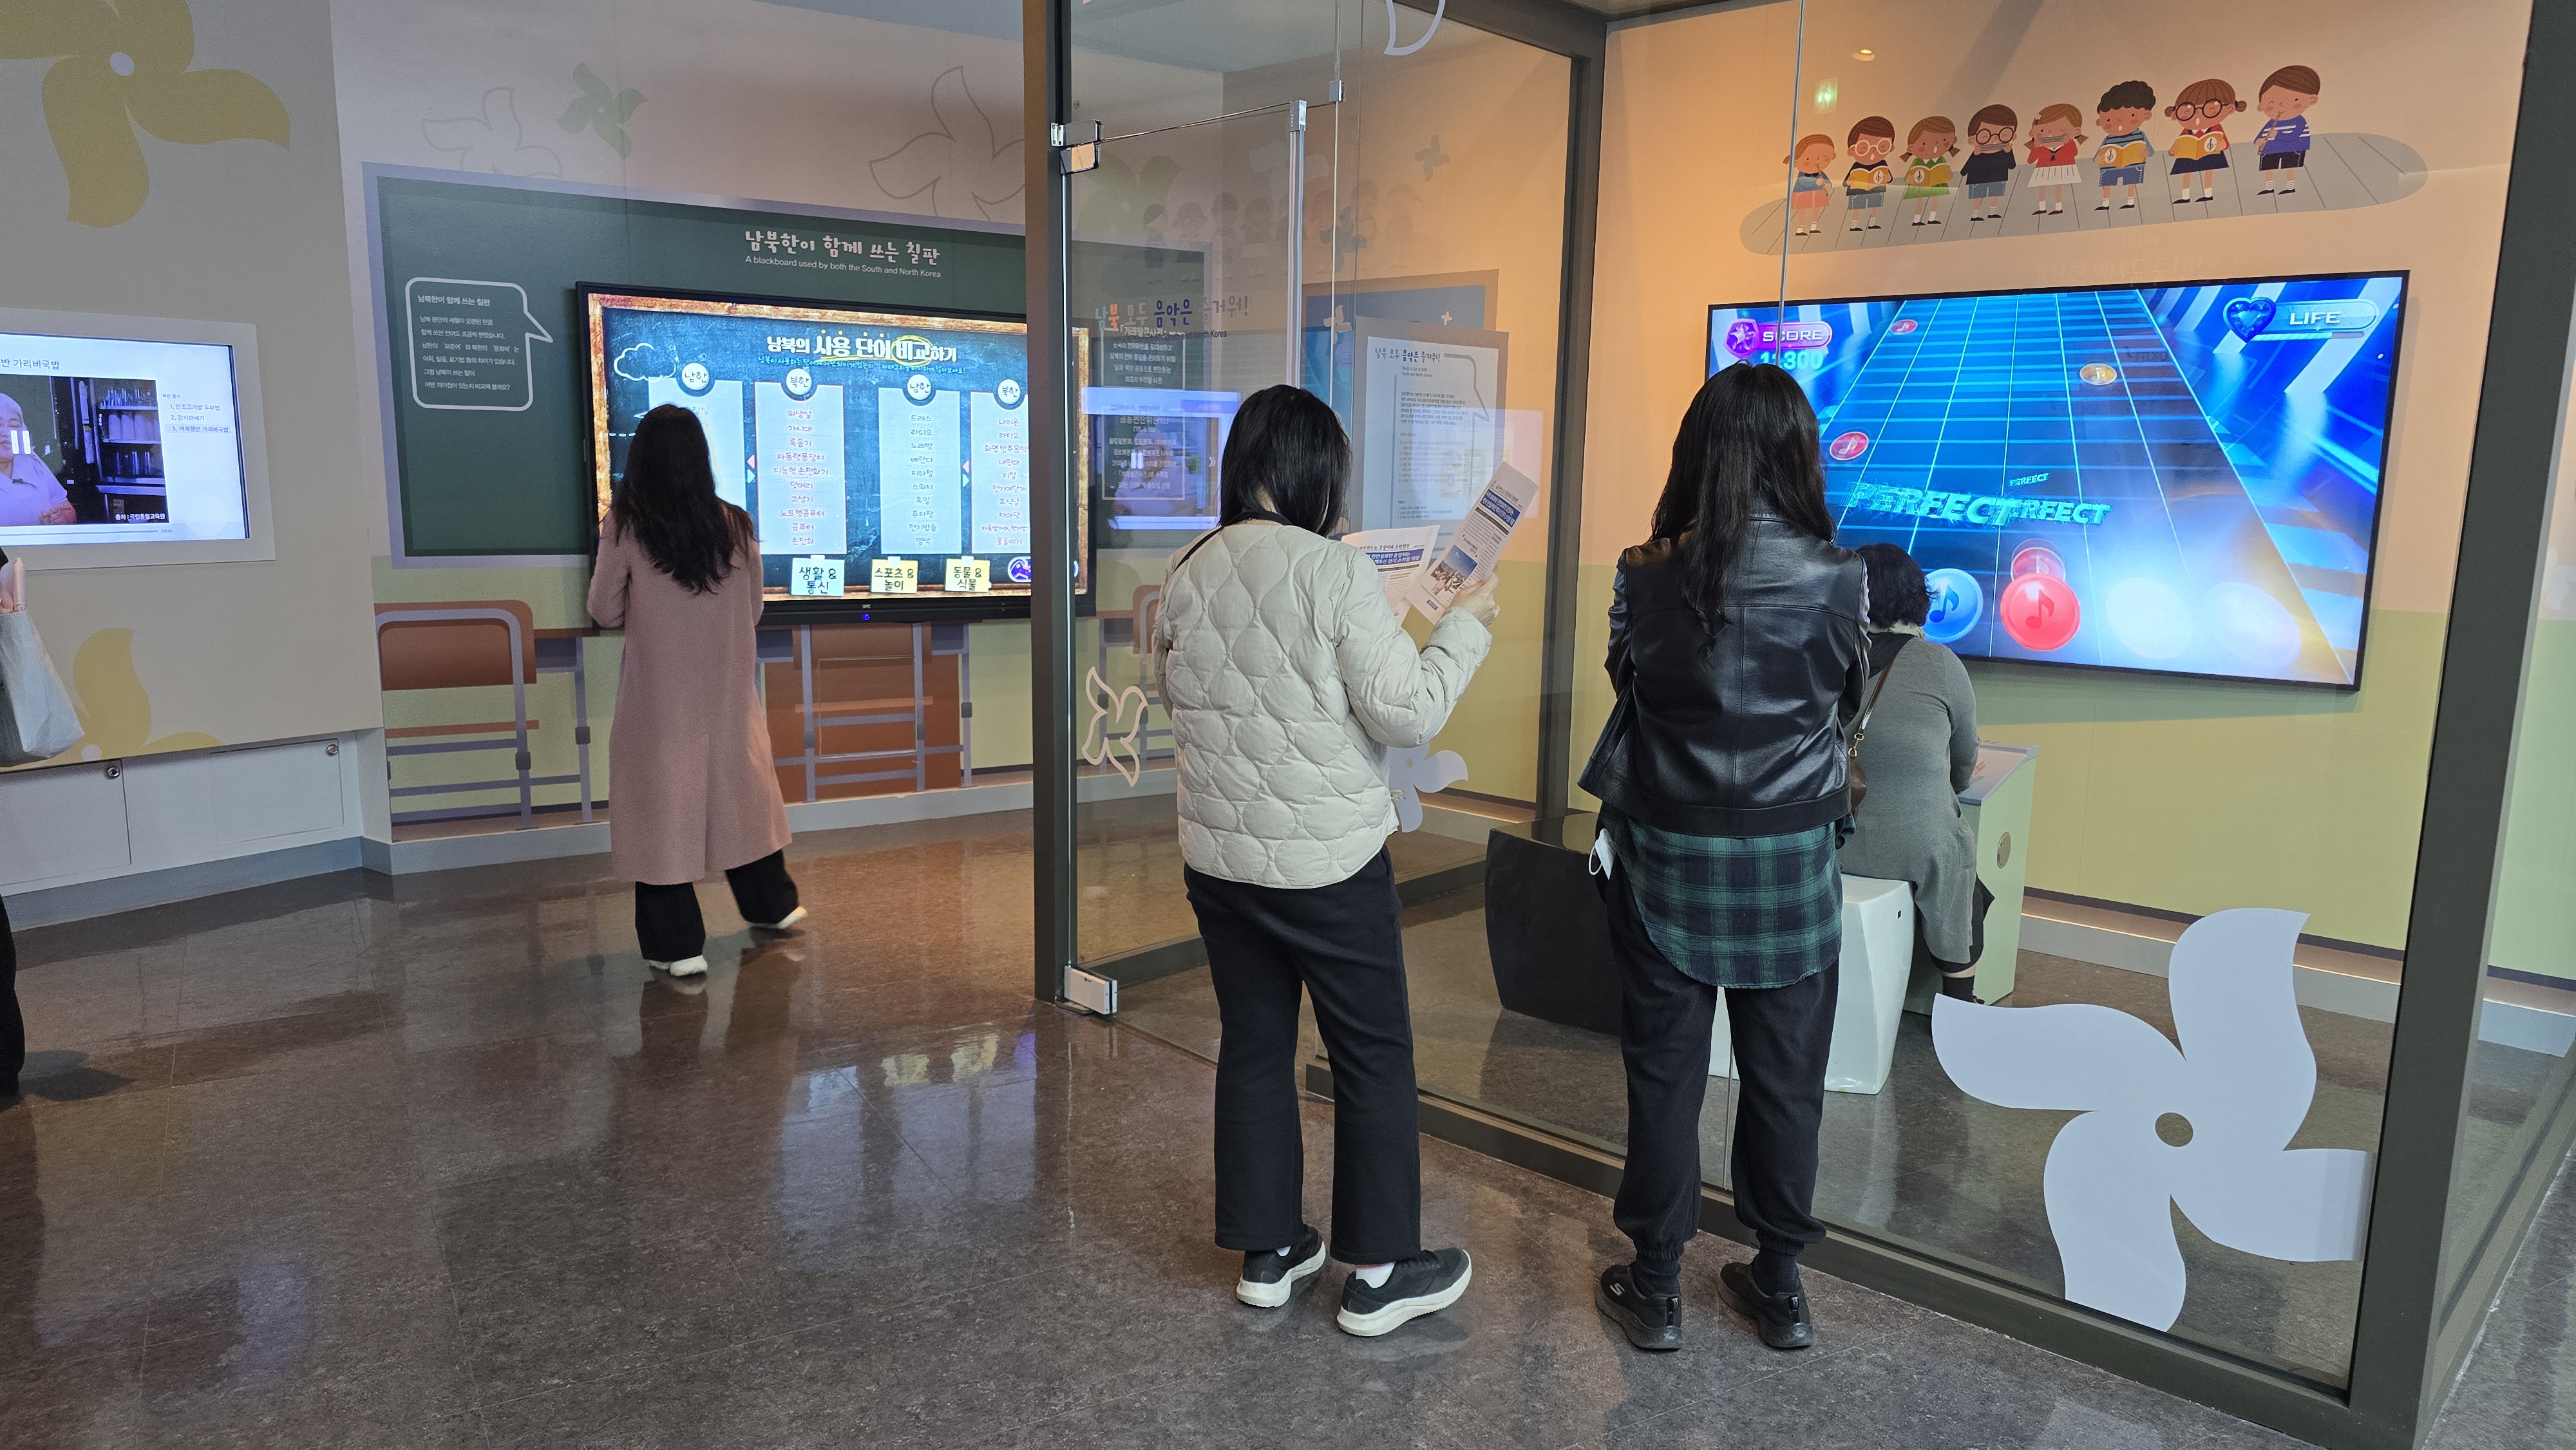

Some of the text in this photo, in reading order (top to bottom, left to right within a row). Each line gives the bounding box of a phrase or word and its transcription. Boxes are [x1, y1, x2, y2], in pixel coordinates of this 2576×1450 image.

[745, 231, 940, 265] 남북한이 함께 쓰는 칠판
[753, 256, 797, 267] blackboard
[862, 265, 882, 273] South
[418, 295, 445, 303] 남북한이
[1095, 303, 1119, 332] 남북
[1124, 302, 1148, 326] 모두
[1154, 298, 1192, 328] 음악은
[2289, 311, 2341, 325] LIFE
[1211, 329, 1227, 338] Korea
[767, 335, 957, 362] 남북의 사용 단어 비교하기
[758, 355, 777, 364] 남북이
[778, 357, 802, 366] 사용하는
[1375, 348, 1440, 363] 남북 모두 음악은 즐거워!
[13, 359, 59, 370] 가리비국밥
[685, 372, 707, 383] 남한
[790, 376, 810, 388] 북한
[910, 382, 930, 393] 남한
[1002, 386, 1019, 397] 북한
[998, 418, 1019, 427] 나리옷
[911, 442, 933, 451] 노래방
[910, 456, 934, 464] 베란다
[798, 467, 829, 476] 손전화기
[911, 469, 933, 478] 지하철
[2010, 473, 2049, 487] PERFECT
[916, 496, 930, 505] 휴일
[1847, 482, 2023, 526] PERFECT
[911, 510, 934, 518] 주차장
[791, 537, 814, 545] 손전화
[799, 567, 837, 581] 생활 &
[874, 567, 914, 578] 스포츠 &
[953, 567, 982, 579] 동물 &
[806, 580, 829, 594] 통신
[884, 579, 904, 591] 놀이
[957, 579, 976, 590] 식물
